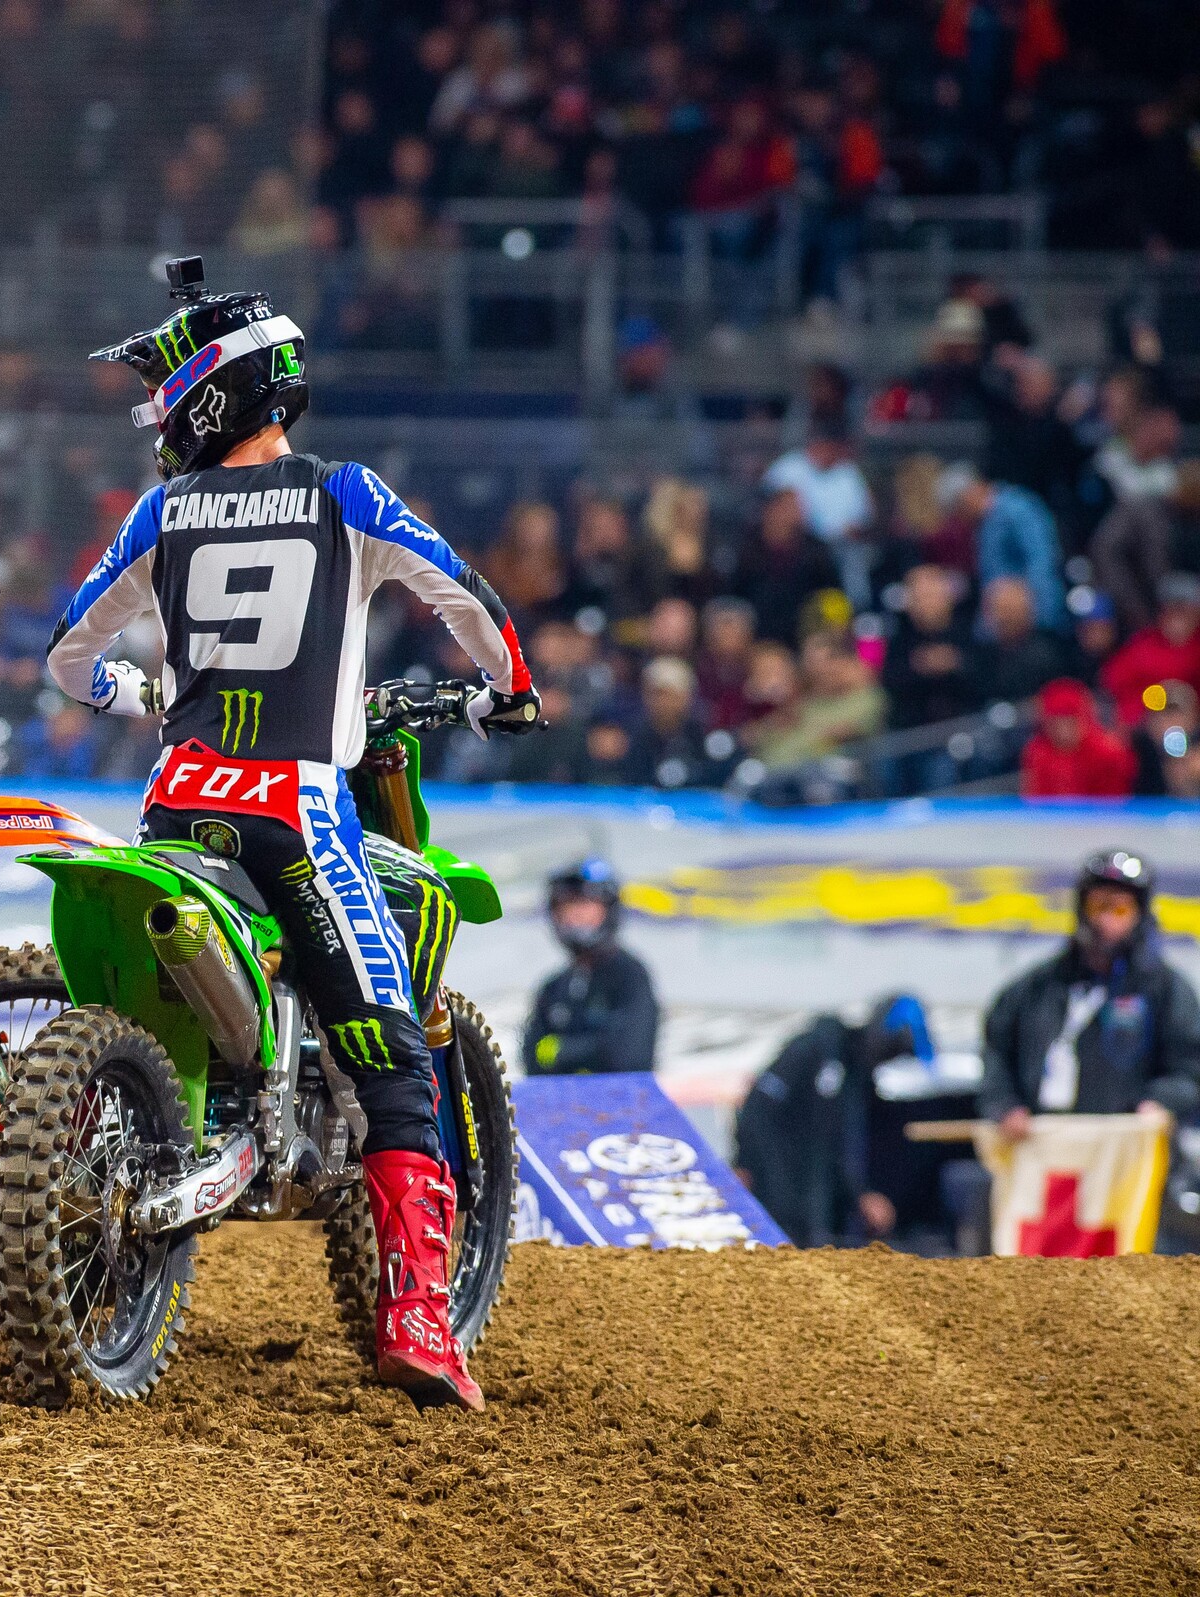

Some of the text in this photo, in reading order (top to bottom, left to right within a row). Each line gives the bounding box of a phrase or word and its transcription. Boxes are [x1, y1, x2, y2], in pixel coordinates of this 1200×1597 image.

[244, 306, 273, 322] FOX
[271, 343, 300, 382] AC
[186, 538, 318, 671] 9
[167, 762, 289, 802] FOX
[18, 815, 53, 829] Bull
[252, 921, 273, 937] 450
[297, 881, 341, 954] MONSTER
[151, 1280, 180, 1359] DUNLOP
